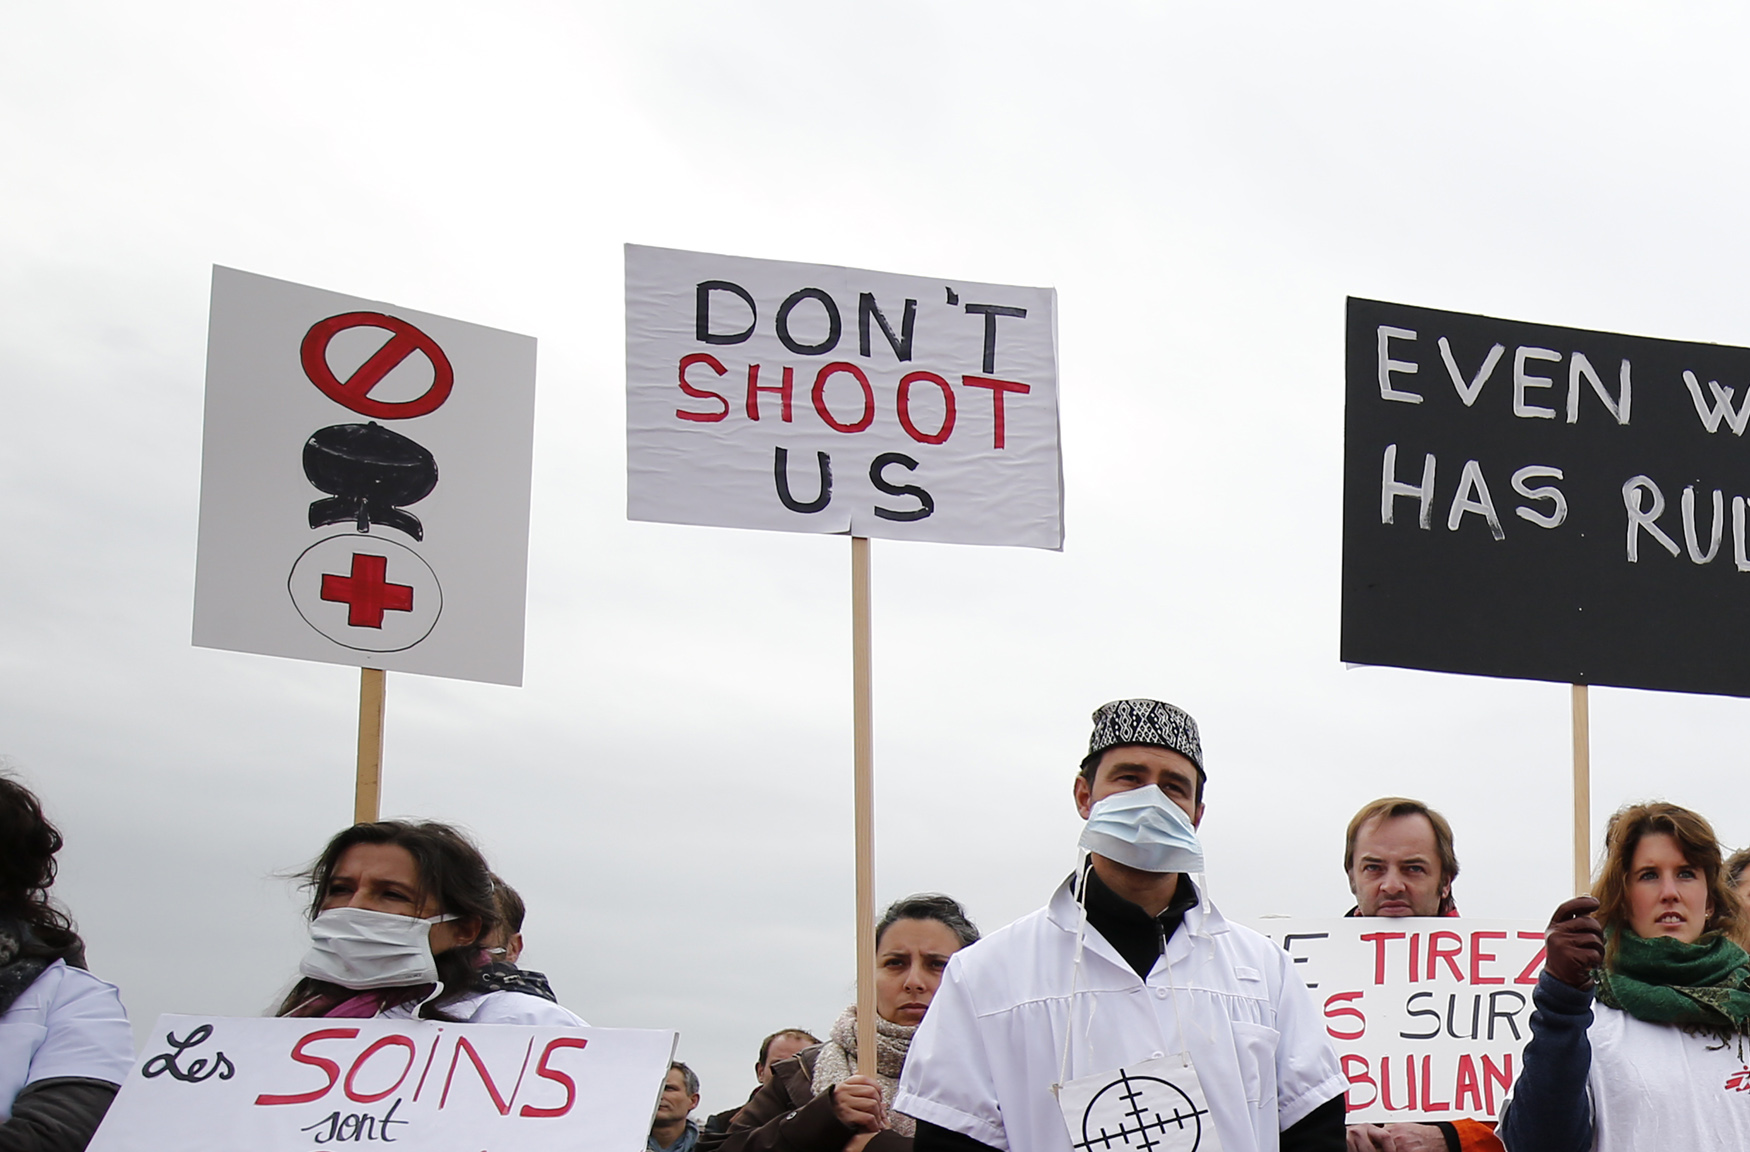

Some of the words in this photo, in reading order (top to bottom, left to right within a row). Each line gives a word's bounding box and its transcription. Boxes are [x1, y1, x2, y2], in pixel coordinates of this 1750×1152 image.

[695, 279, 1028, 374] DON'T
[676, 353, 1032, 449] SHOOT
[1377, 325, 1631, 424] EVEN
[774, 446, 934, 522] US
[1382, 444, 1568, 540] HAS
[1360, 931, 1546, 985] TIREZ
[141, 1024, 235, 1083] Les
[1400, 990, 1527, 1041] SUR
[301, 1098, 409, 1143] sont
